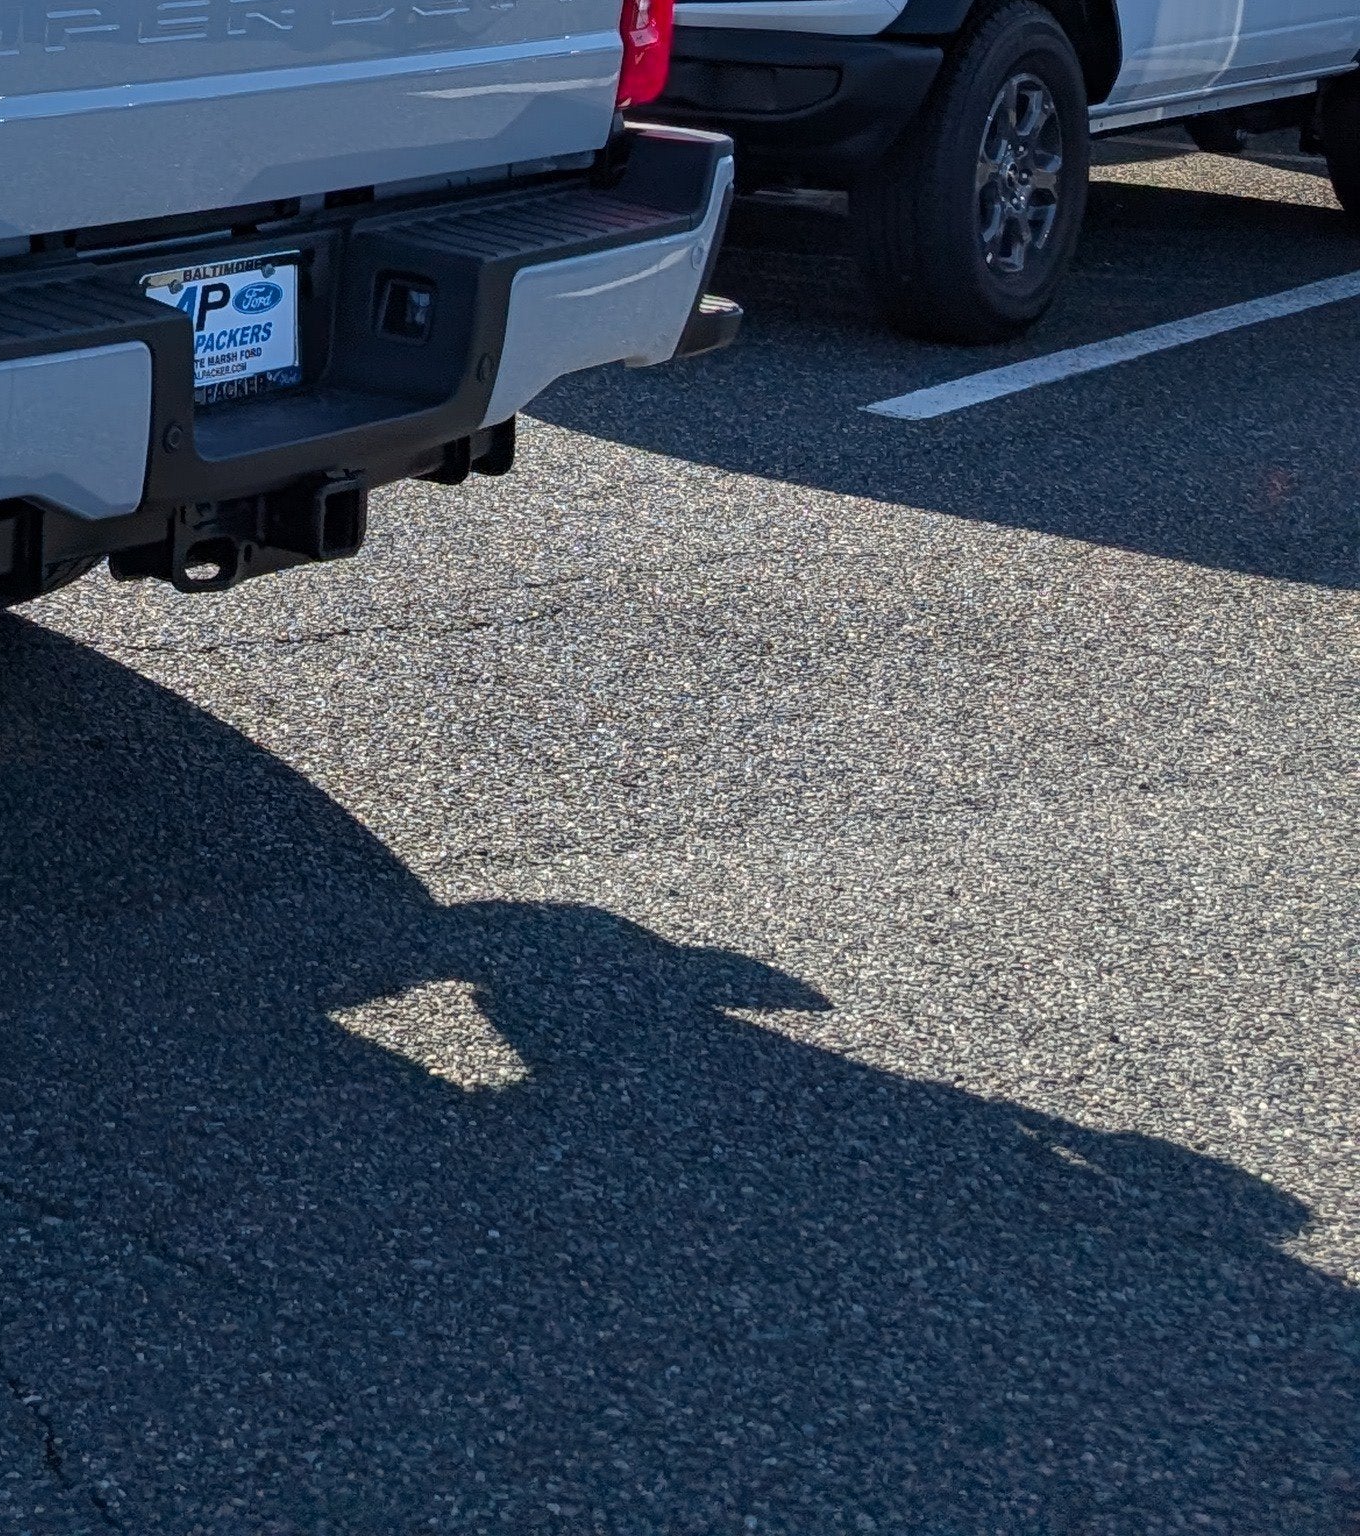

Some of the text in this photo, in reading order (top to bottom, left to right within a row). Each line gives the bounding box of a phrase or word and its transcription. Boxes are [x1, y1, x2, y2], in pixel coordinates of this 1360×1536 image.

[183, 259, 263, 282] BALTIMORE
[242, 285, 273, 310] Ford
[195, 321, 273, 354] PACKERS
[207, 351, 238, 367] MARSH
[240, 347, 263, 361] FORD
